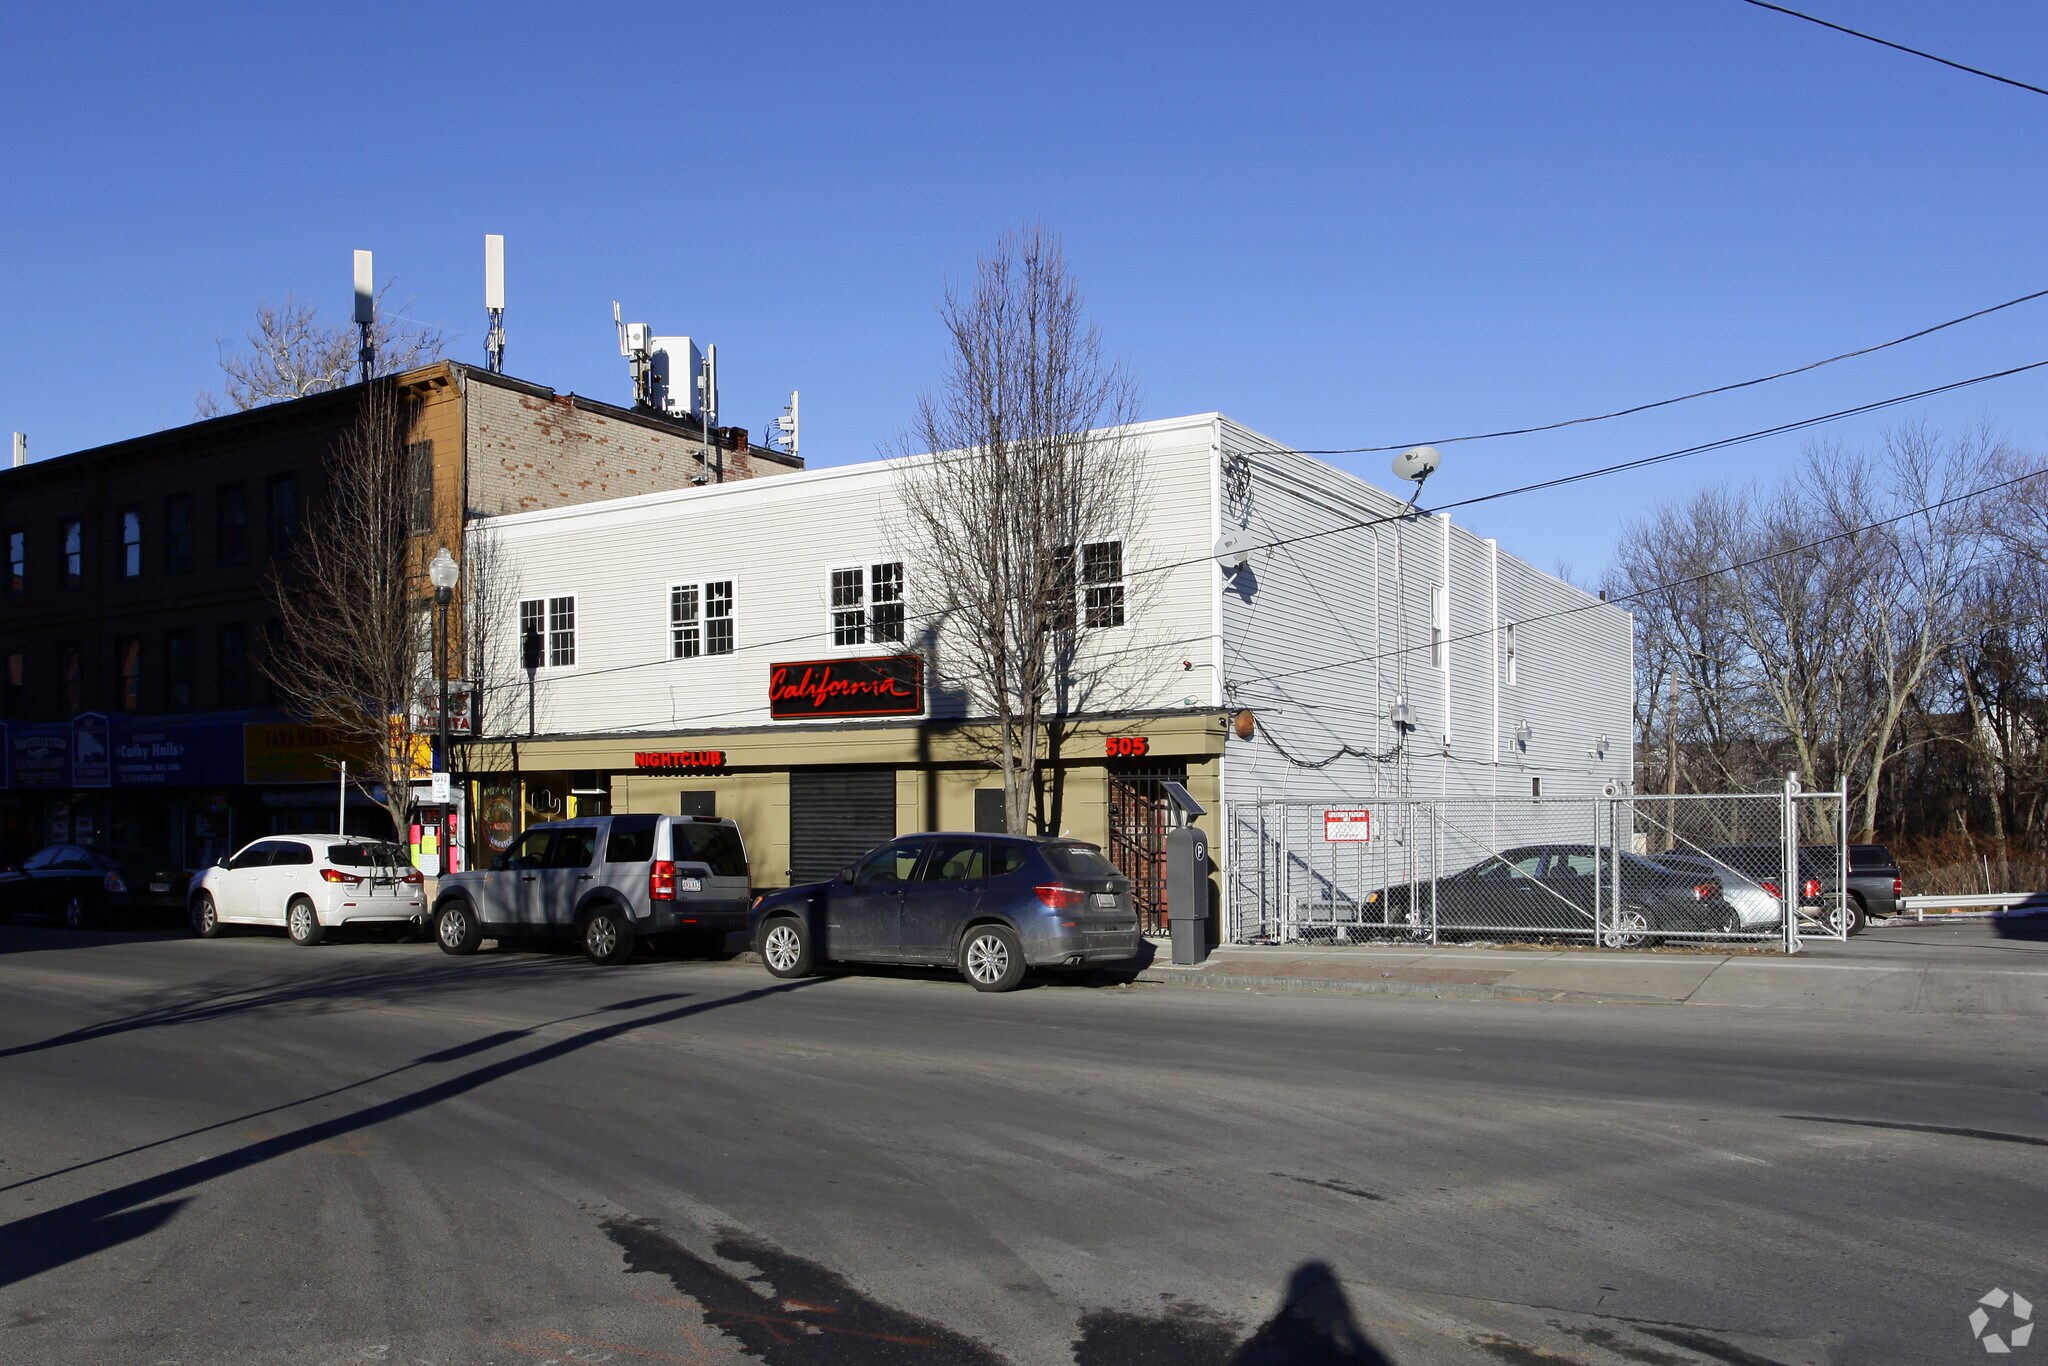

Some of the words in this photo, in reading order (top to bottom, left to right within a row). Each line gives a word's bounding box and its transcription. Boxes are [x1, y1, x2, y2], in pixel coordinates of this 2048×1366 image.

[769, 667, 912, 707] California
[121, 743, 149, 760] Cathy
[152, 742, 178, 757] Nails
[1105, 737, 1147, 756] 505
[634, 750, 722, 767] NIGHTCLUB
